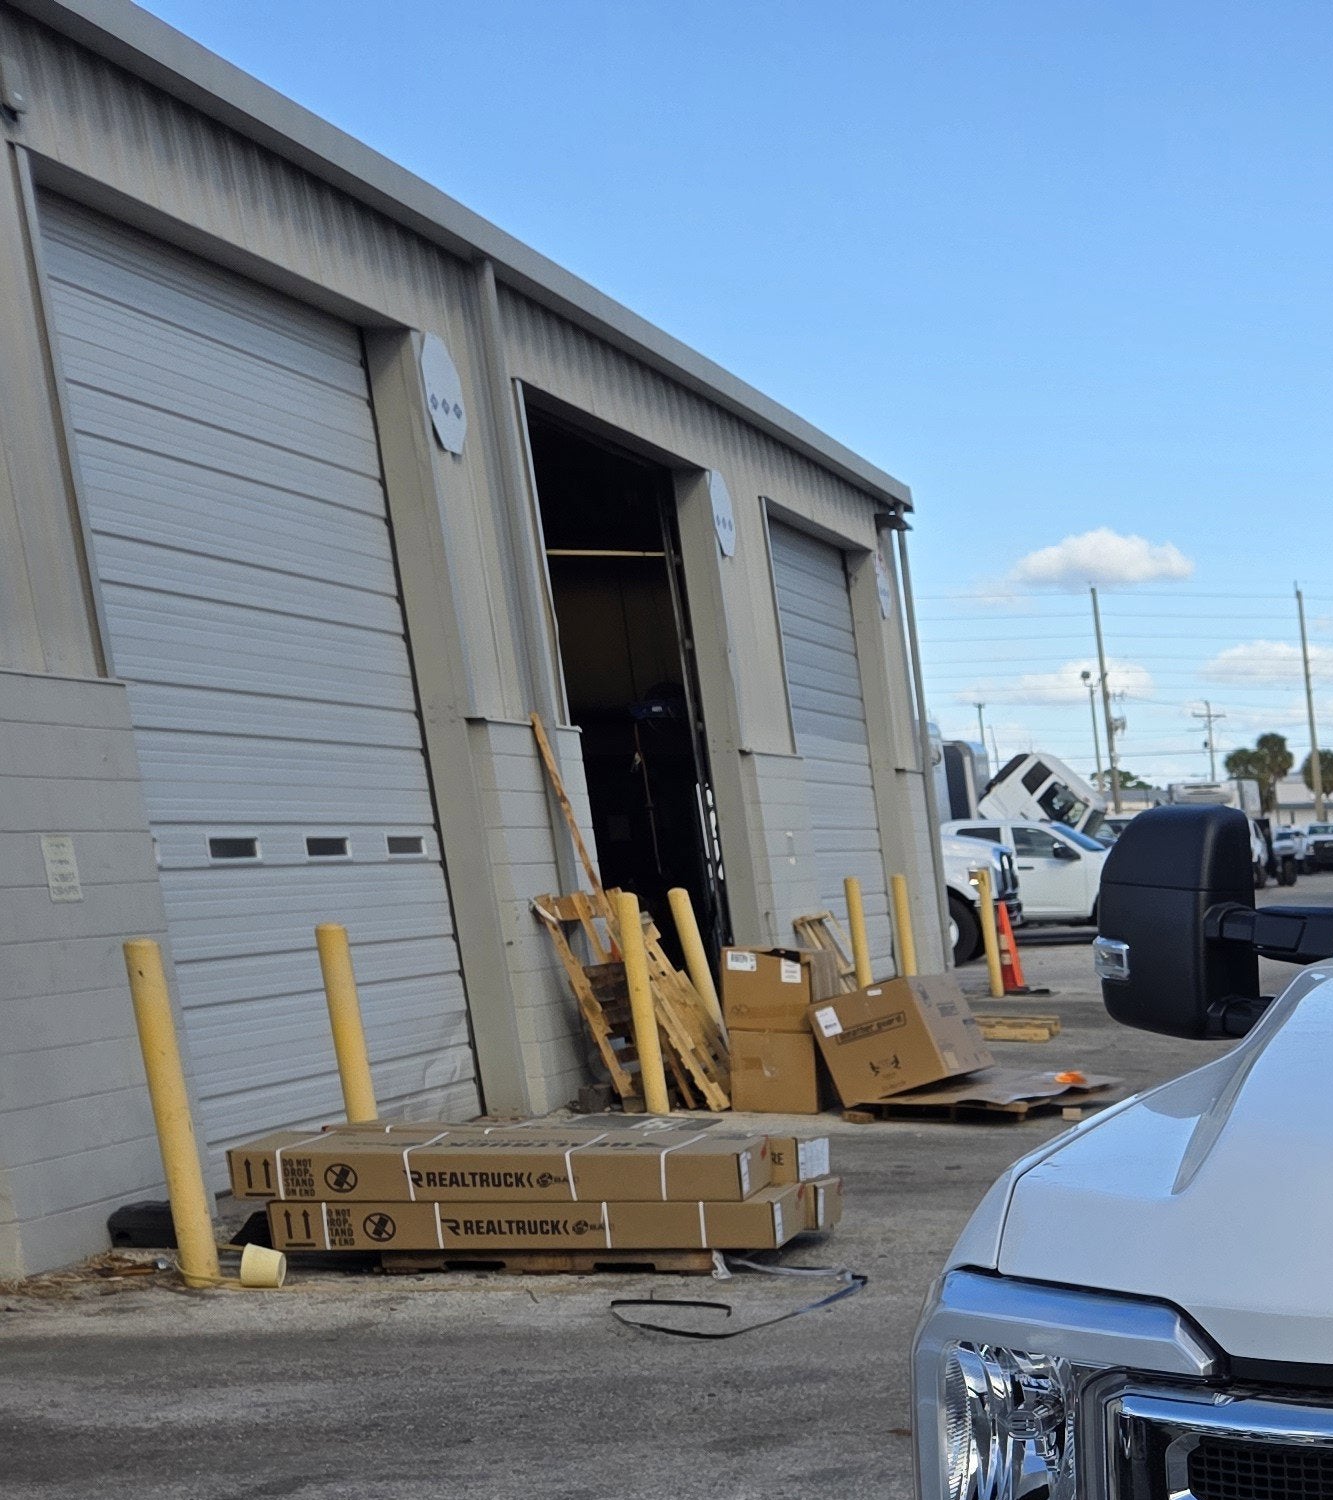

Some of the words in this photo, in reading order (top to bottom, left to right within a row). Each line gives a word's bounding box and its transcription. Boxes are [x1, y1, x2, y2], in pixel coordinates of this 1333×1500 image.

[296, 1159, 312, 1168] NOT
[285, 1178, 315, 1187] STAND
[426, 1171, 525, 1188] REALTRUCK
[285, 1188, 297, 1197] ON
[299, 1188, 316, 1197] END
[335, 1209, 351, 1218] NOT
[463, 1219, 563, 1235] REALTRUCK
[330, 1228, 354, 1237] TAND
[338, 1237, 355, 1247] END
